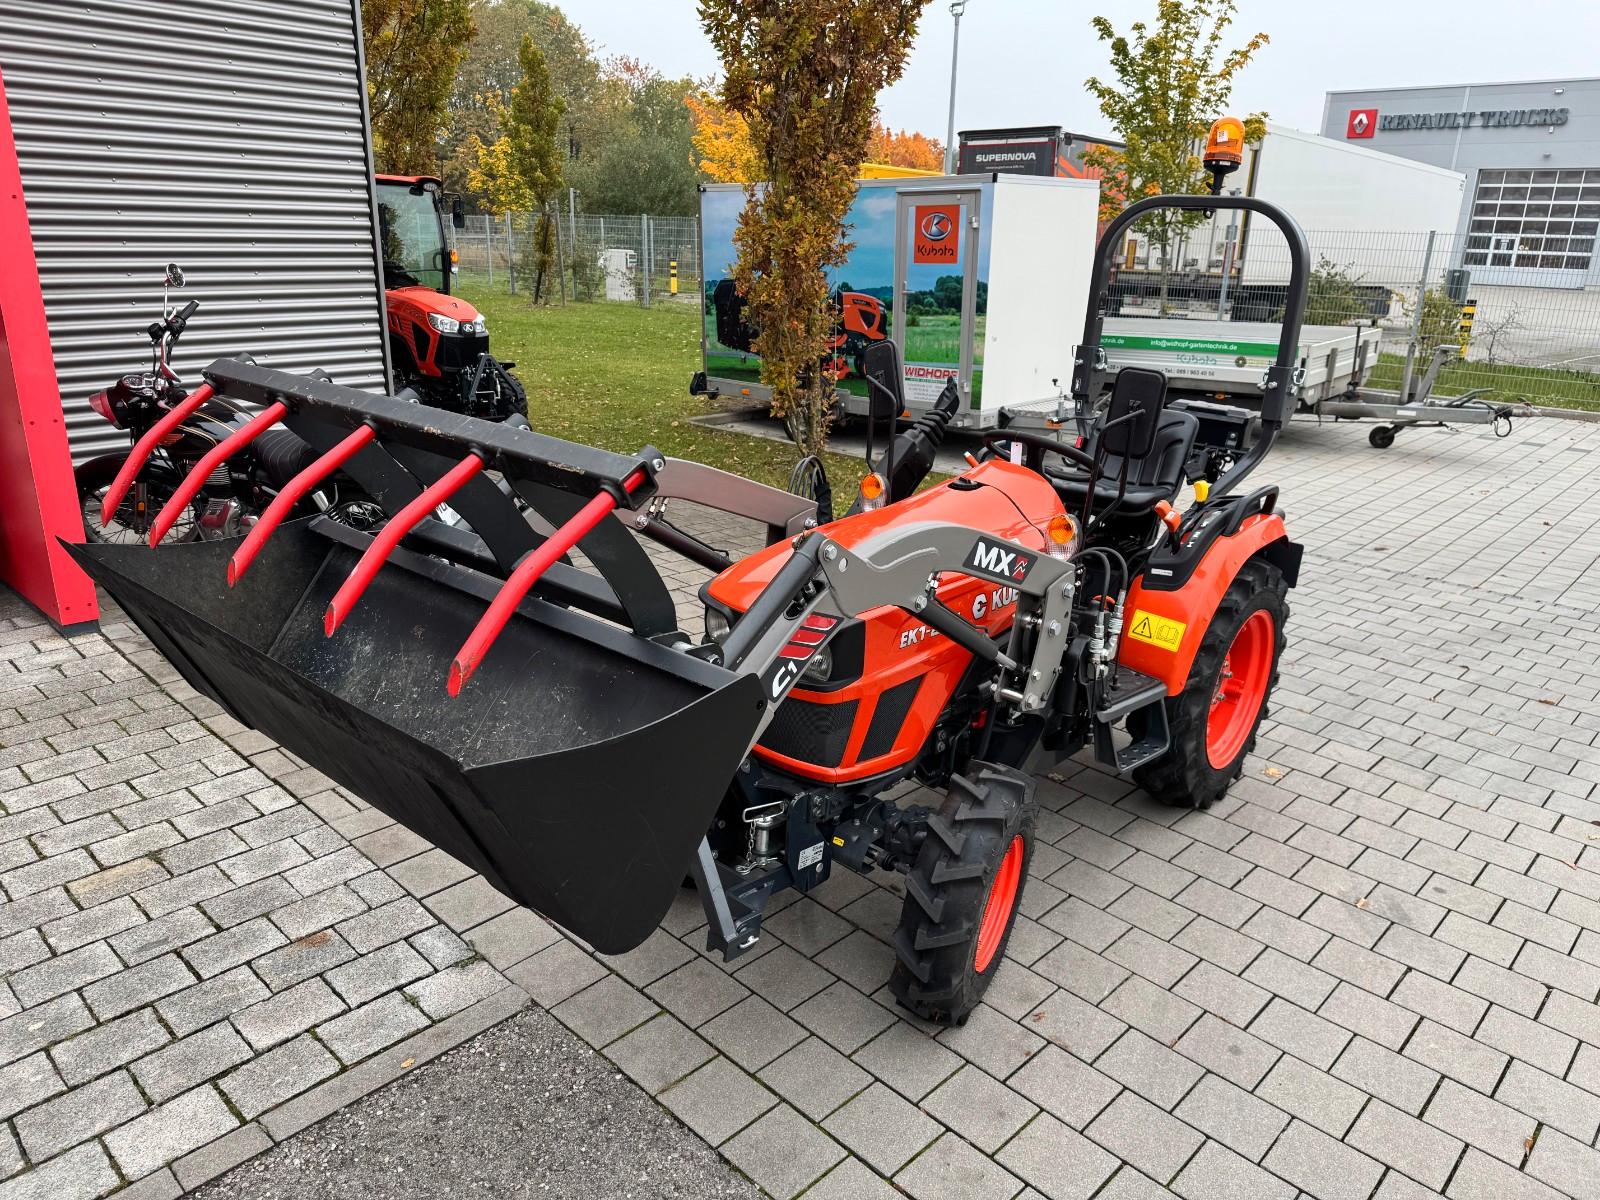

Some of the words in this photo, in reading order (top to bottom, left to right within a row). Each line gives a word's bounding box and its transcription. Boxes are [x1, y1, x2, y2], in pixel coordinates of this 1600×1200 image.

[1379, 112, 1475, 131] RENAULT
[1479, 108, 1569, 127] TRUCKS
[975, 152, 1037, 162] SUPERNOVA
[917, 244, 954, 257] Kubota
[973, 541, 1016, 577] MX
